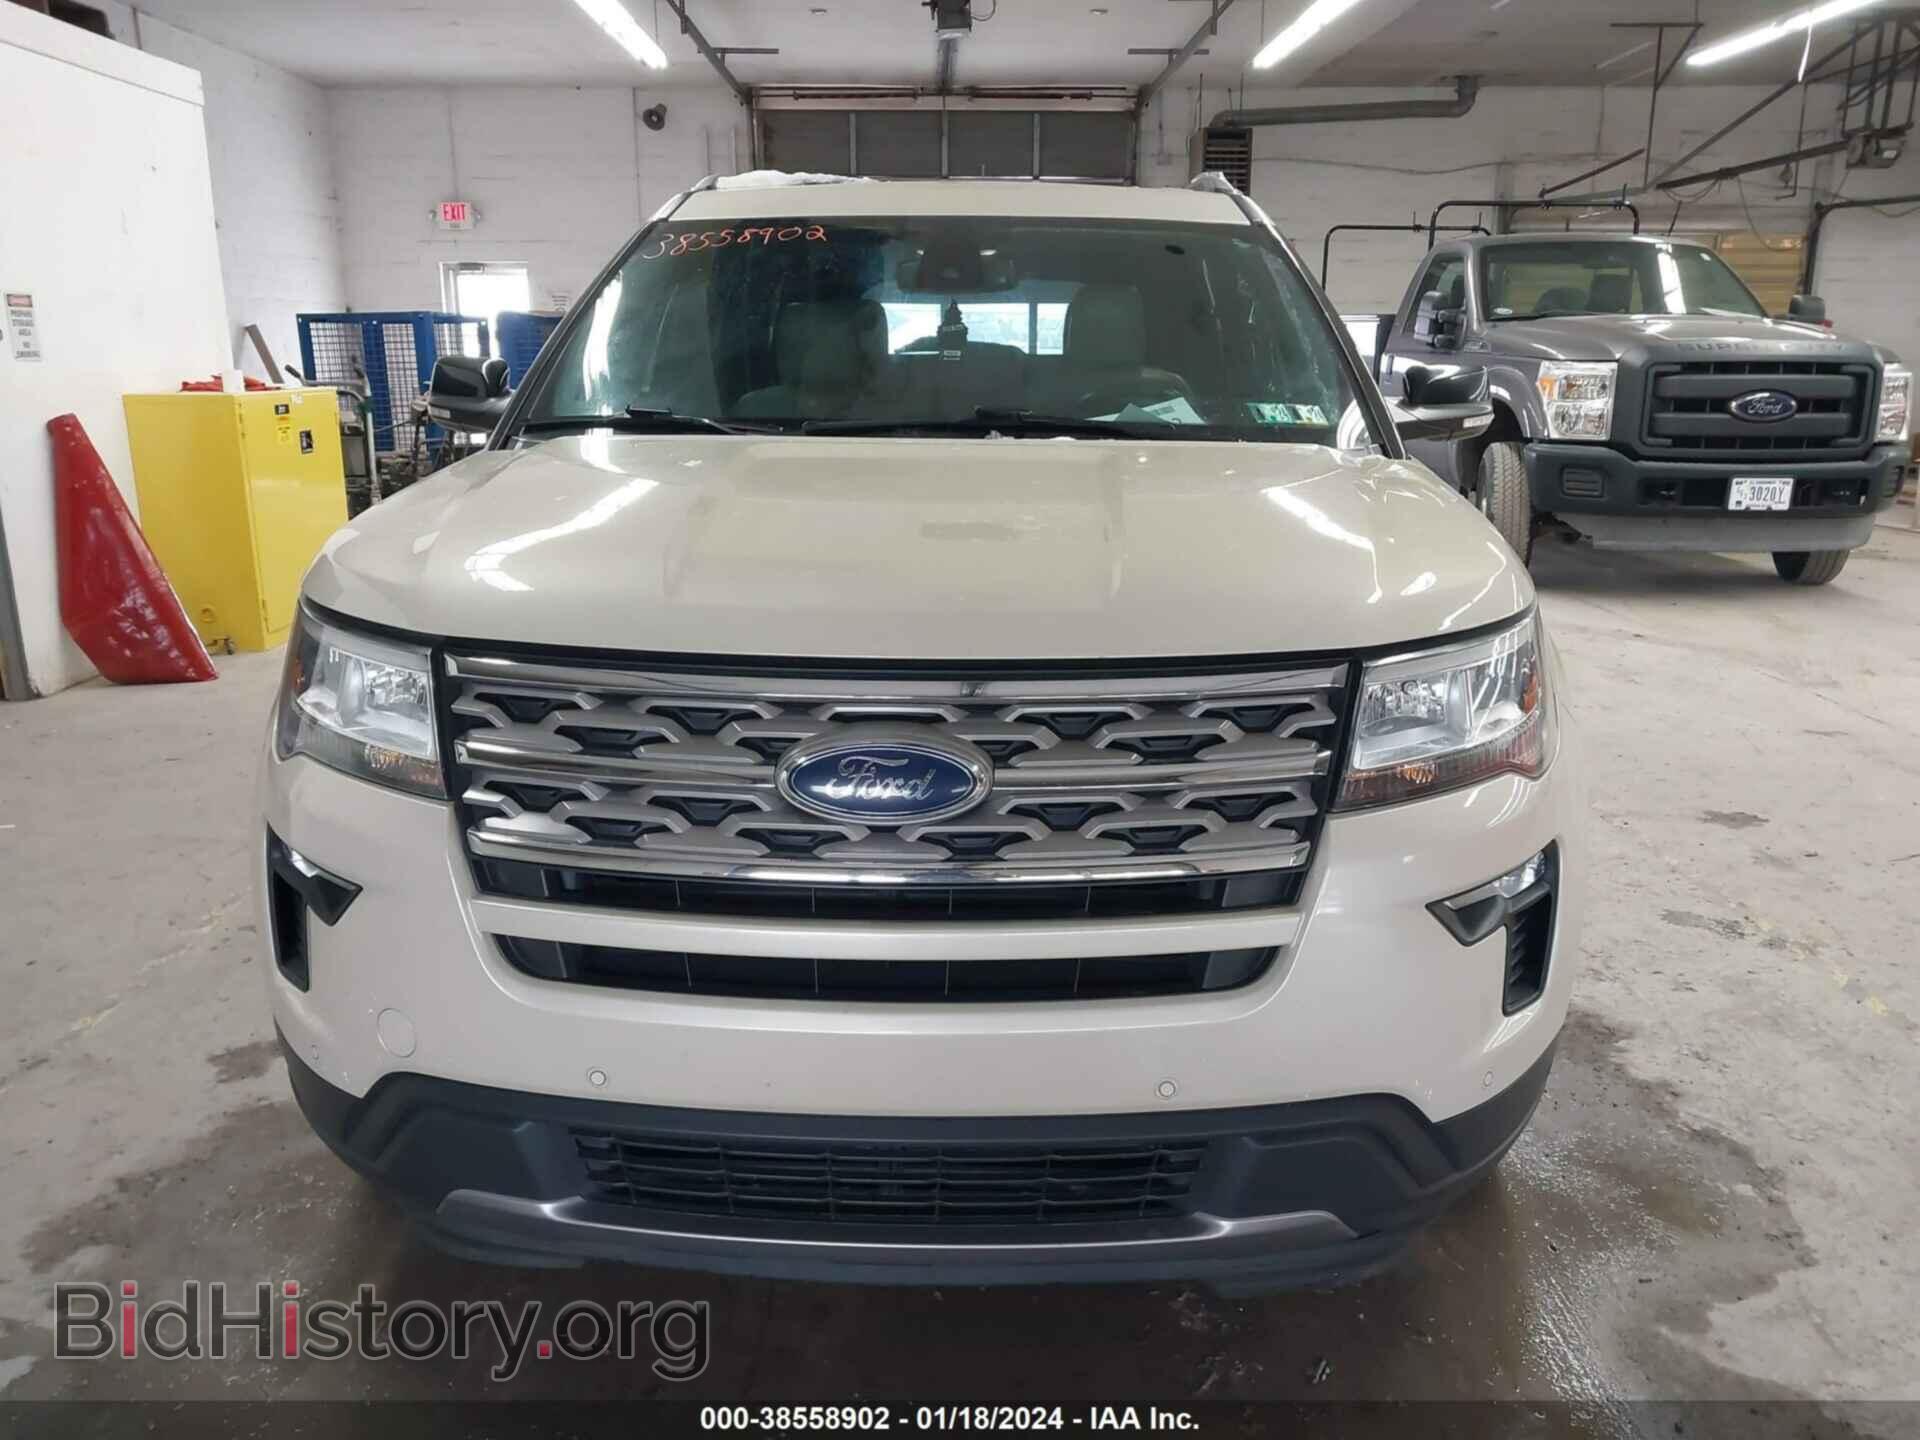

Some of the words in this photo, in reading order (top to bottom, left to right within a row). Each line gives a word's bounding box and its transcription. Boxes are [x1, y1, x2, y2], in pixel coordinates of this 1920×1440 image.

[443, 203, 465, 222] EXIT
[643, 225, 828, 260] 38558902
[1747, 399, 1784, 415] Ford
[826, 755, 937, 800] Ford
